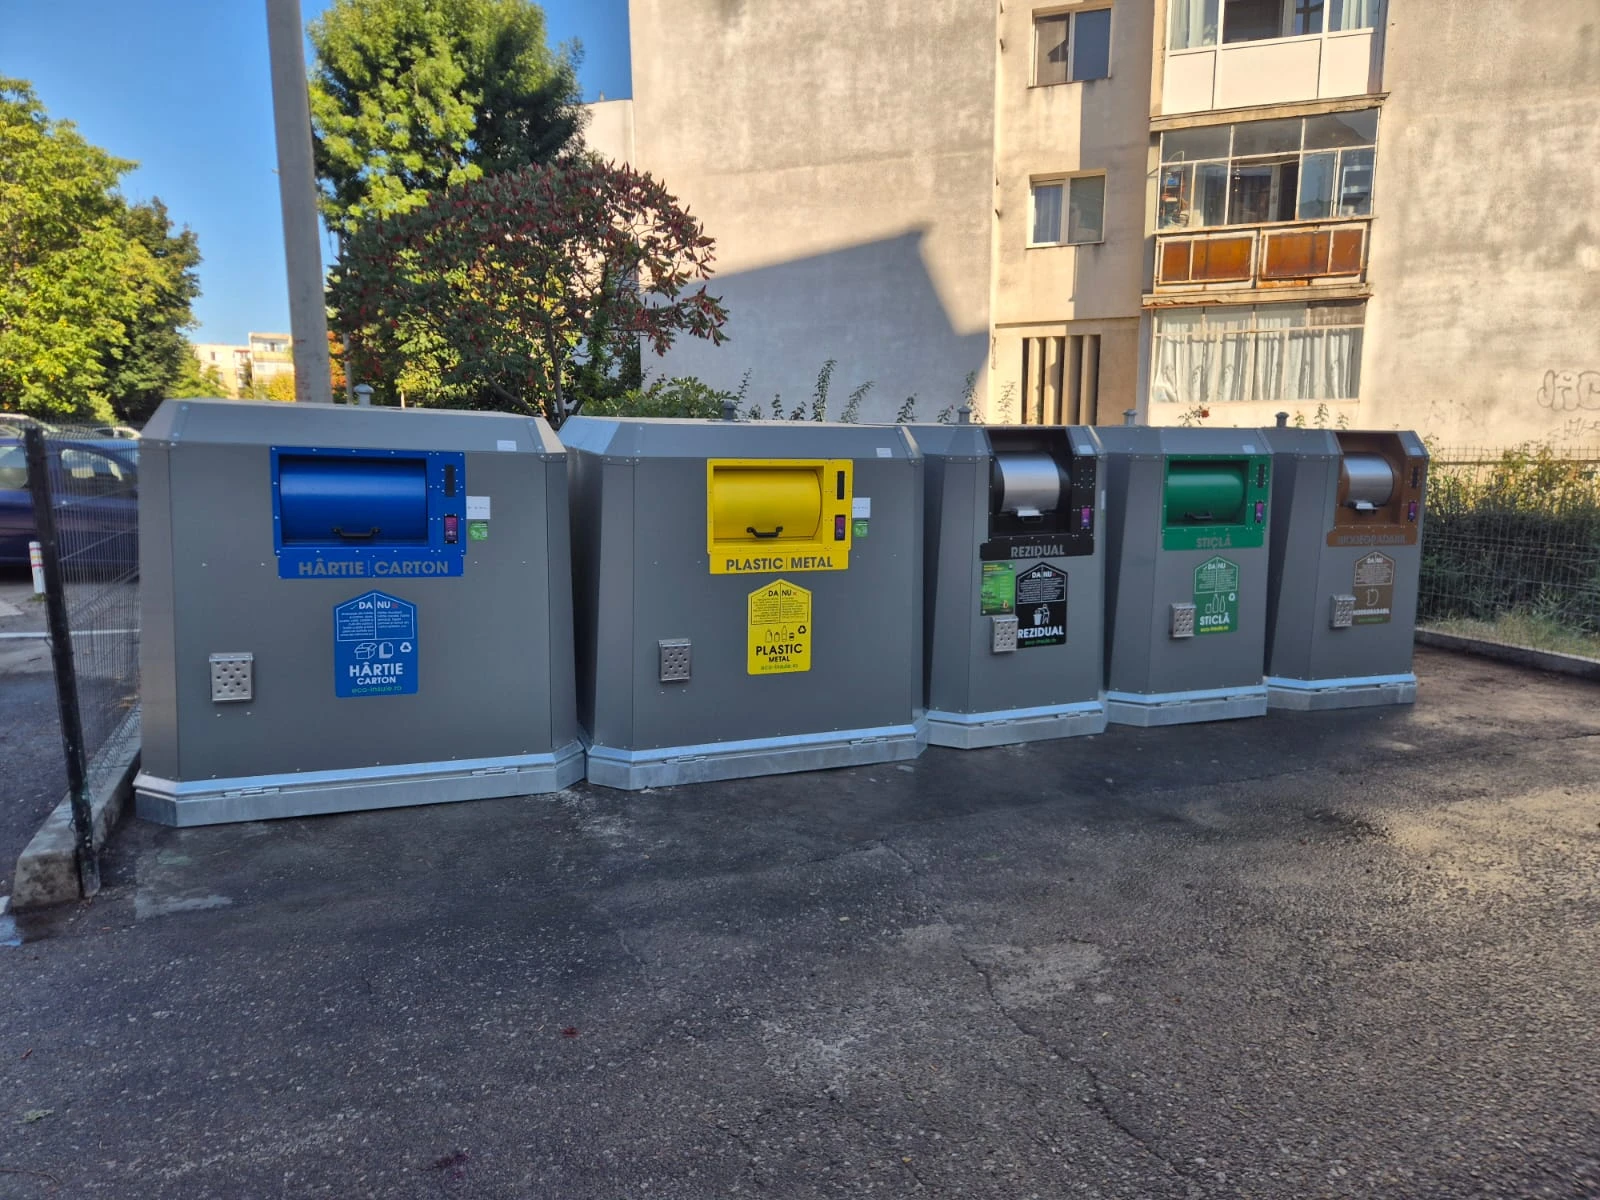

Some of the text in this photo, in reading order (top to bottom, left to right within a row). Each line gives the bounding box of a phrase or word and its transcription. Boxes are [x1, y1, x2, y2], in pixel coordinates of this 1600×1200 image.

[1011, 544, 1065, 558] REZIDUAL
[298, 558, 449, 576] HÂRTIE CARTON
[726, 556, 833, 571] PLASTIC METAL
[358, 601, 391, 610] DA NU
[1017, 625, 1064, 639] REZIDUAL
[756, 643, 803, 656] PLASTIC
[768, 655, 790, 663] METAL
[349, 661, 403, 677] HÂRTIE
[356, 676, 397, 685] CARTON
